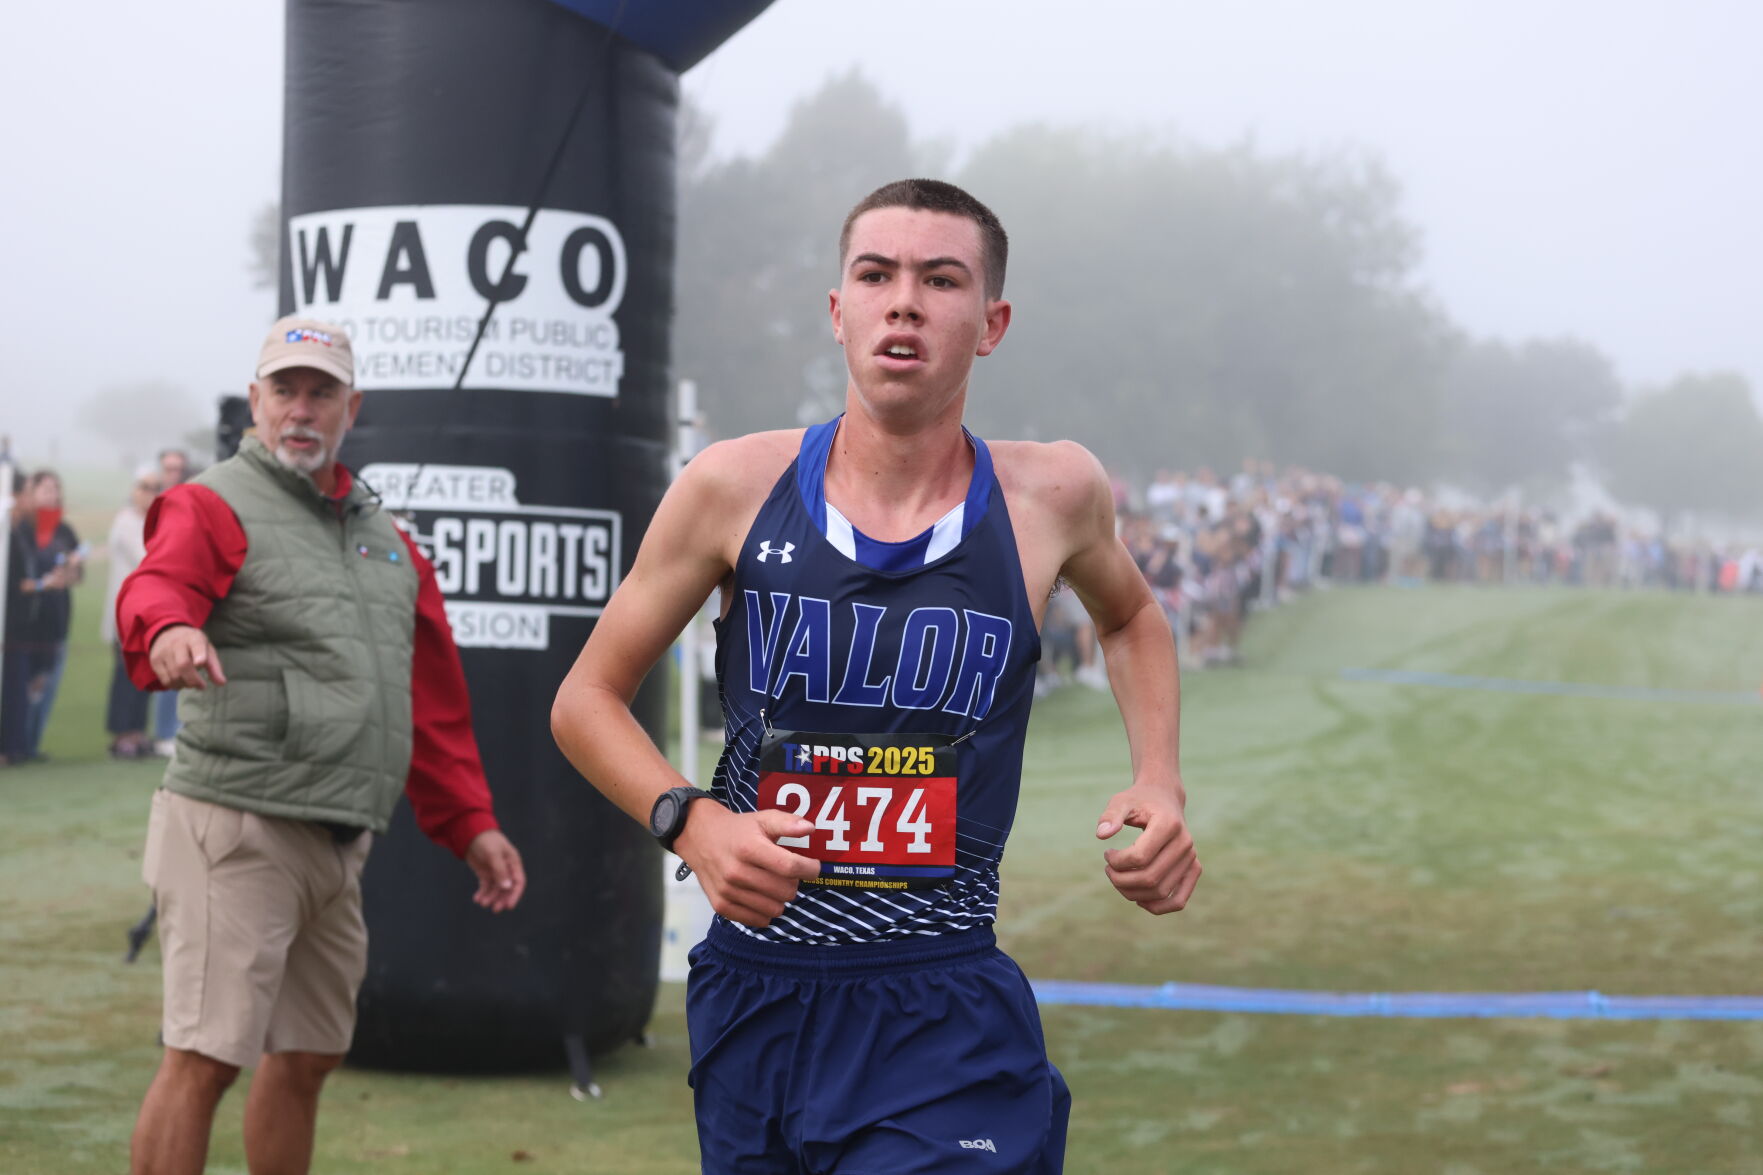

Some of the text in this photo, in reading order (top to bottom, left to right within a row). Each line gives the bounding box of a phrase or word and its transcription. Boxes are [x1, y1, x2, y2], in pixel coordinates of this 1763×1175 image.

[297, 219, 616, 308] WACO
[363, 316, 499, 343] TOURISM
[509, 318, 610, 350] PUBLIC
[355, 351, 615, 384] VEMENT DISTRICT
[366, 471, 507, 500] GREATER
[432, 517, 609, 600] SPORTS
[449, 610, 543, 640] SION
[744, 589, 1012, 721] VALOR
[781, 743, 935, 775] TAPPS 2025
[775, 783, 932, 853] 2474
[824, 878, 854, 887] COUNTRY
[854, 880, 908, 889] CHAMPIONSHIPS
[833, 865, 875, 875] WACO, TEXAS
[958, 1138, 997, 1154] BOA
